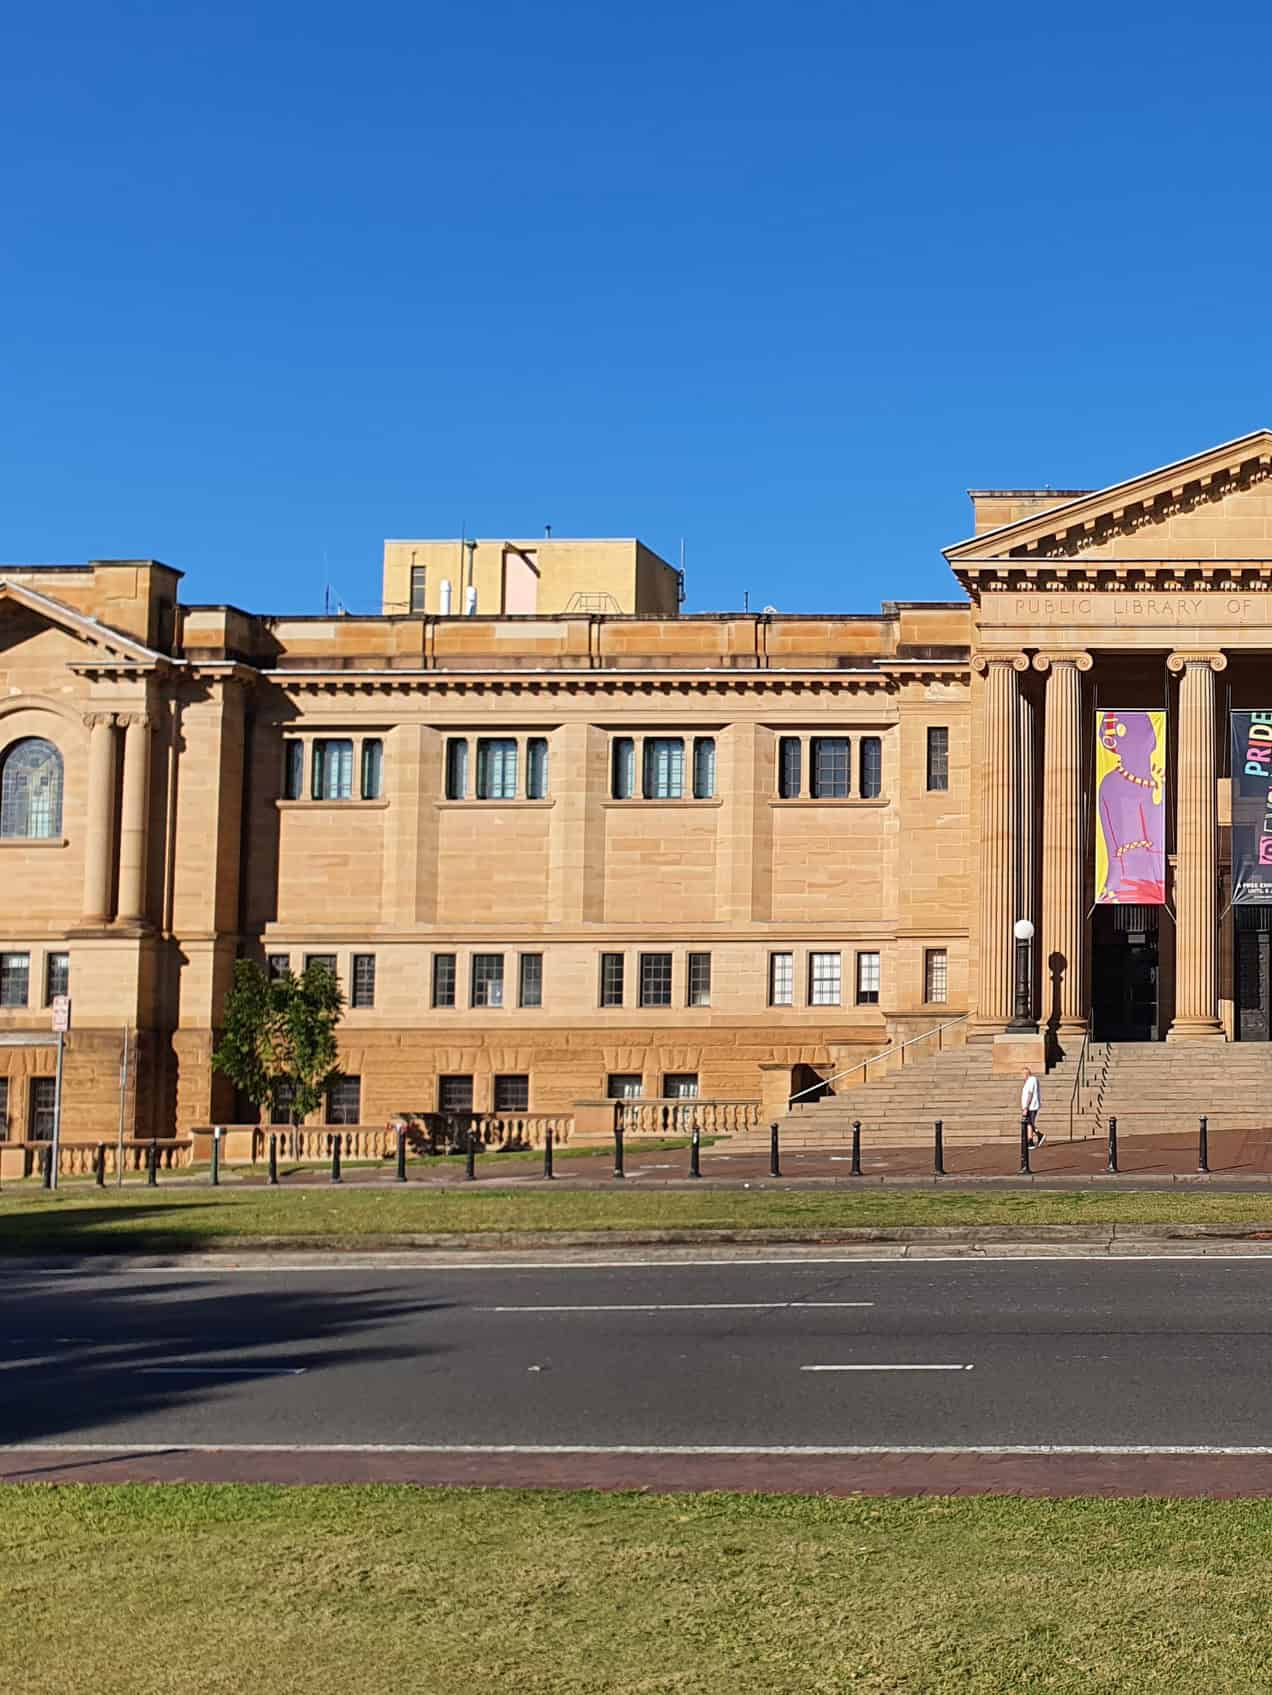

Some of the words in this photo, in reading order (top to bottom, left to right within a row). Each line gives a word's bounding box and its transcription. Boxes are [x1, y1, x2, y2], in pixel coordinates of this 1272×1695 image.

[1015, 599, 1091, 614] PUBLIC
[1113, 599, 1202, 614] LIBRARY
[1226, 599, 1252, 614] OF
